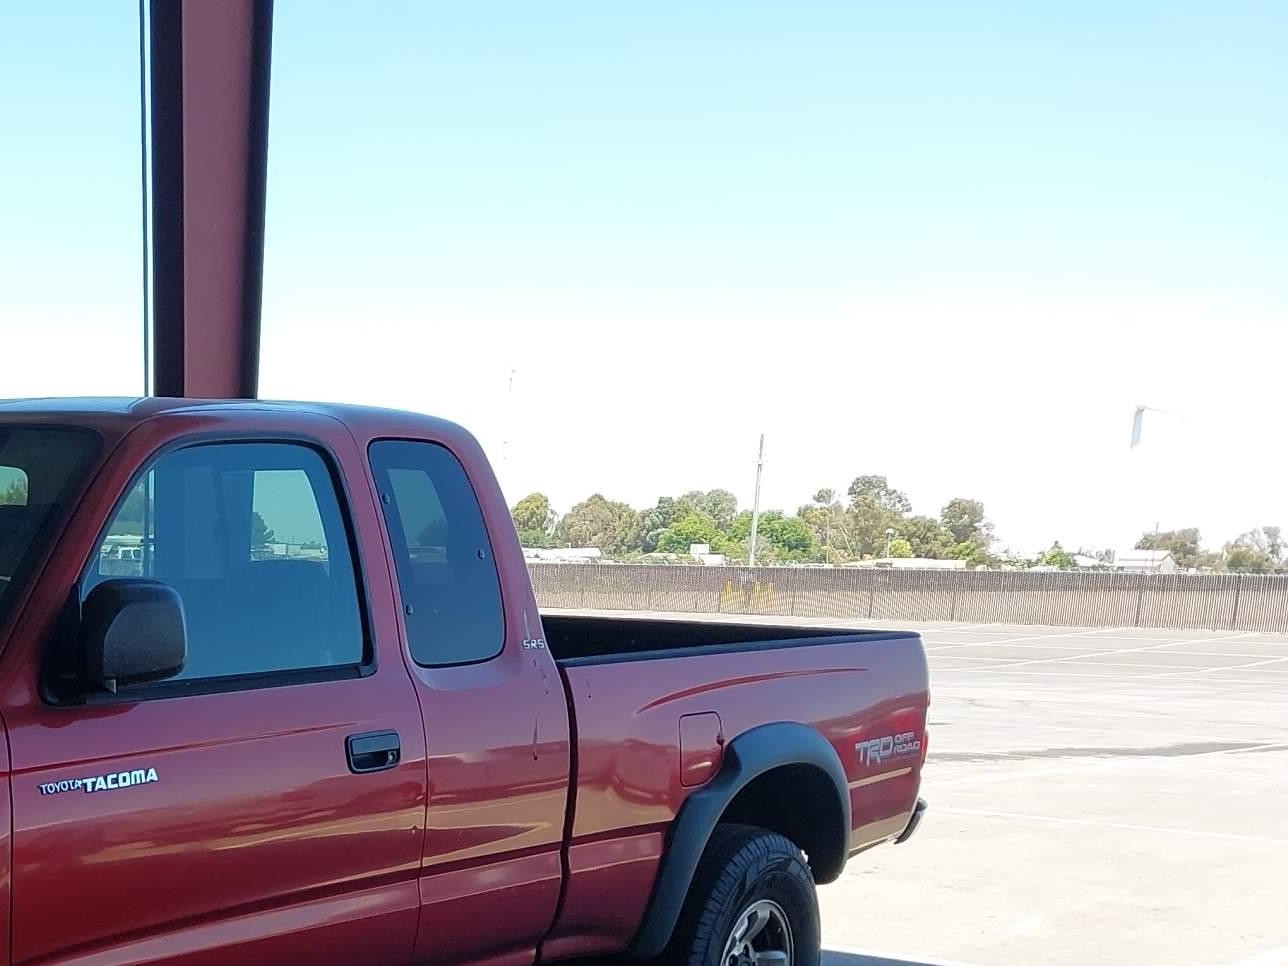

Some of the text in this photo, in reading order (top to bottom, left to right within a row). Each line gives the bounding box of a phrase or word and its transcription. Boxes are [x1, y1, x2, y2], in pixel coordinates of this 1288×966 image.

[895, 732, 914, 743] OFF
[856, 736, 893, 766] TRD
[894, 742, 920, 754] ROAD
[39, 768, 158, 795] TOYOTA TACOMA
